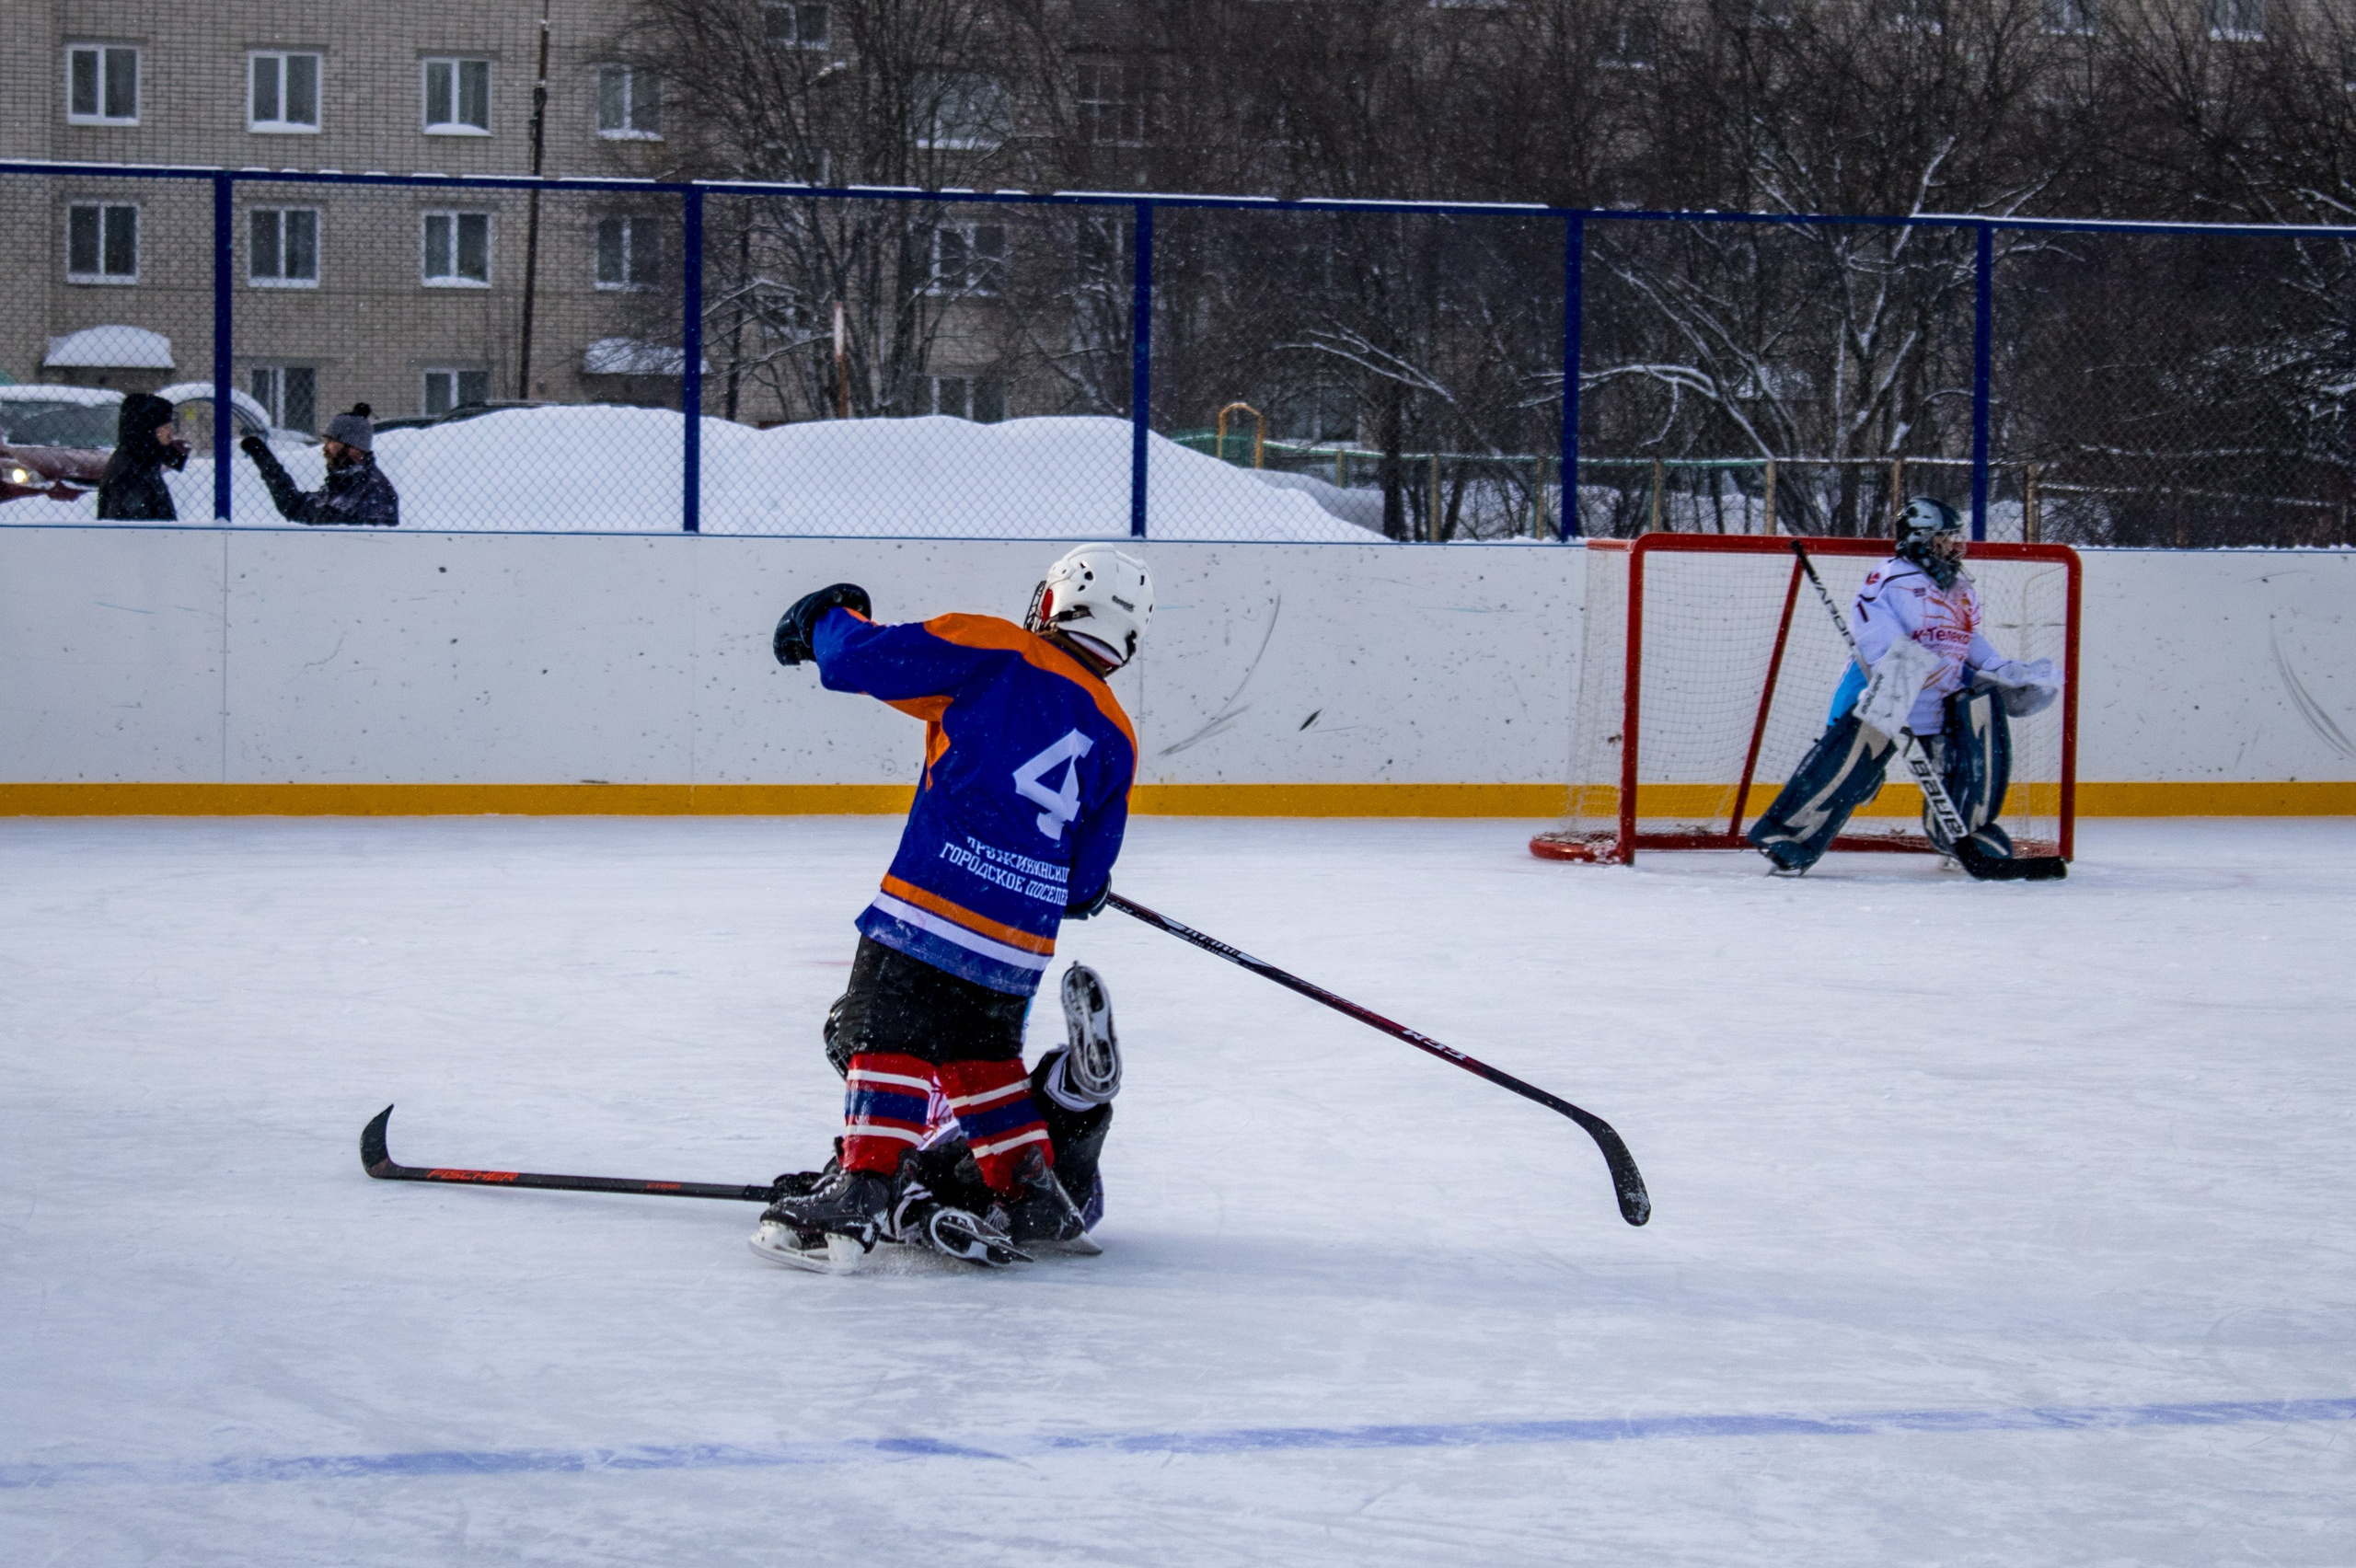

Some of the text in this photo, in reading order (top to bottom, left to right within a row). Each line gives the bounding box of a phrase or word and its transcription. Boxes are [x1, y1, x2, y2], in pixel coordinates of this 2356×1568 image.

[1012, 727, 1094, 841] 4
[939, 842, 1026, 894] ГОРОДСКОЕ
[426, 1168, 519, 1182] FISCHER
